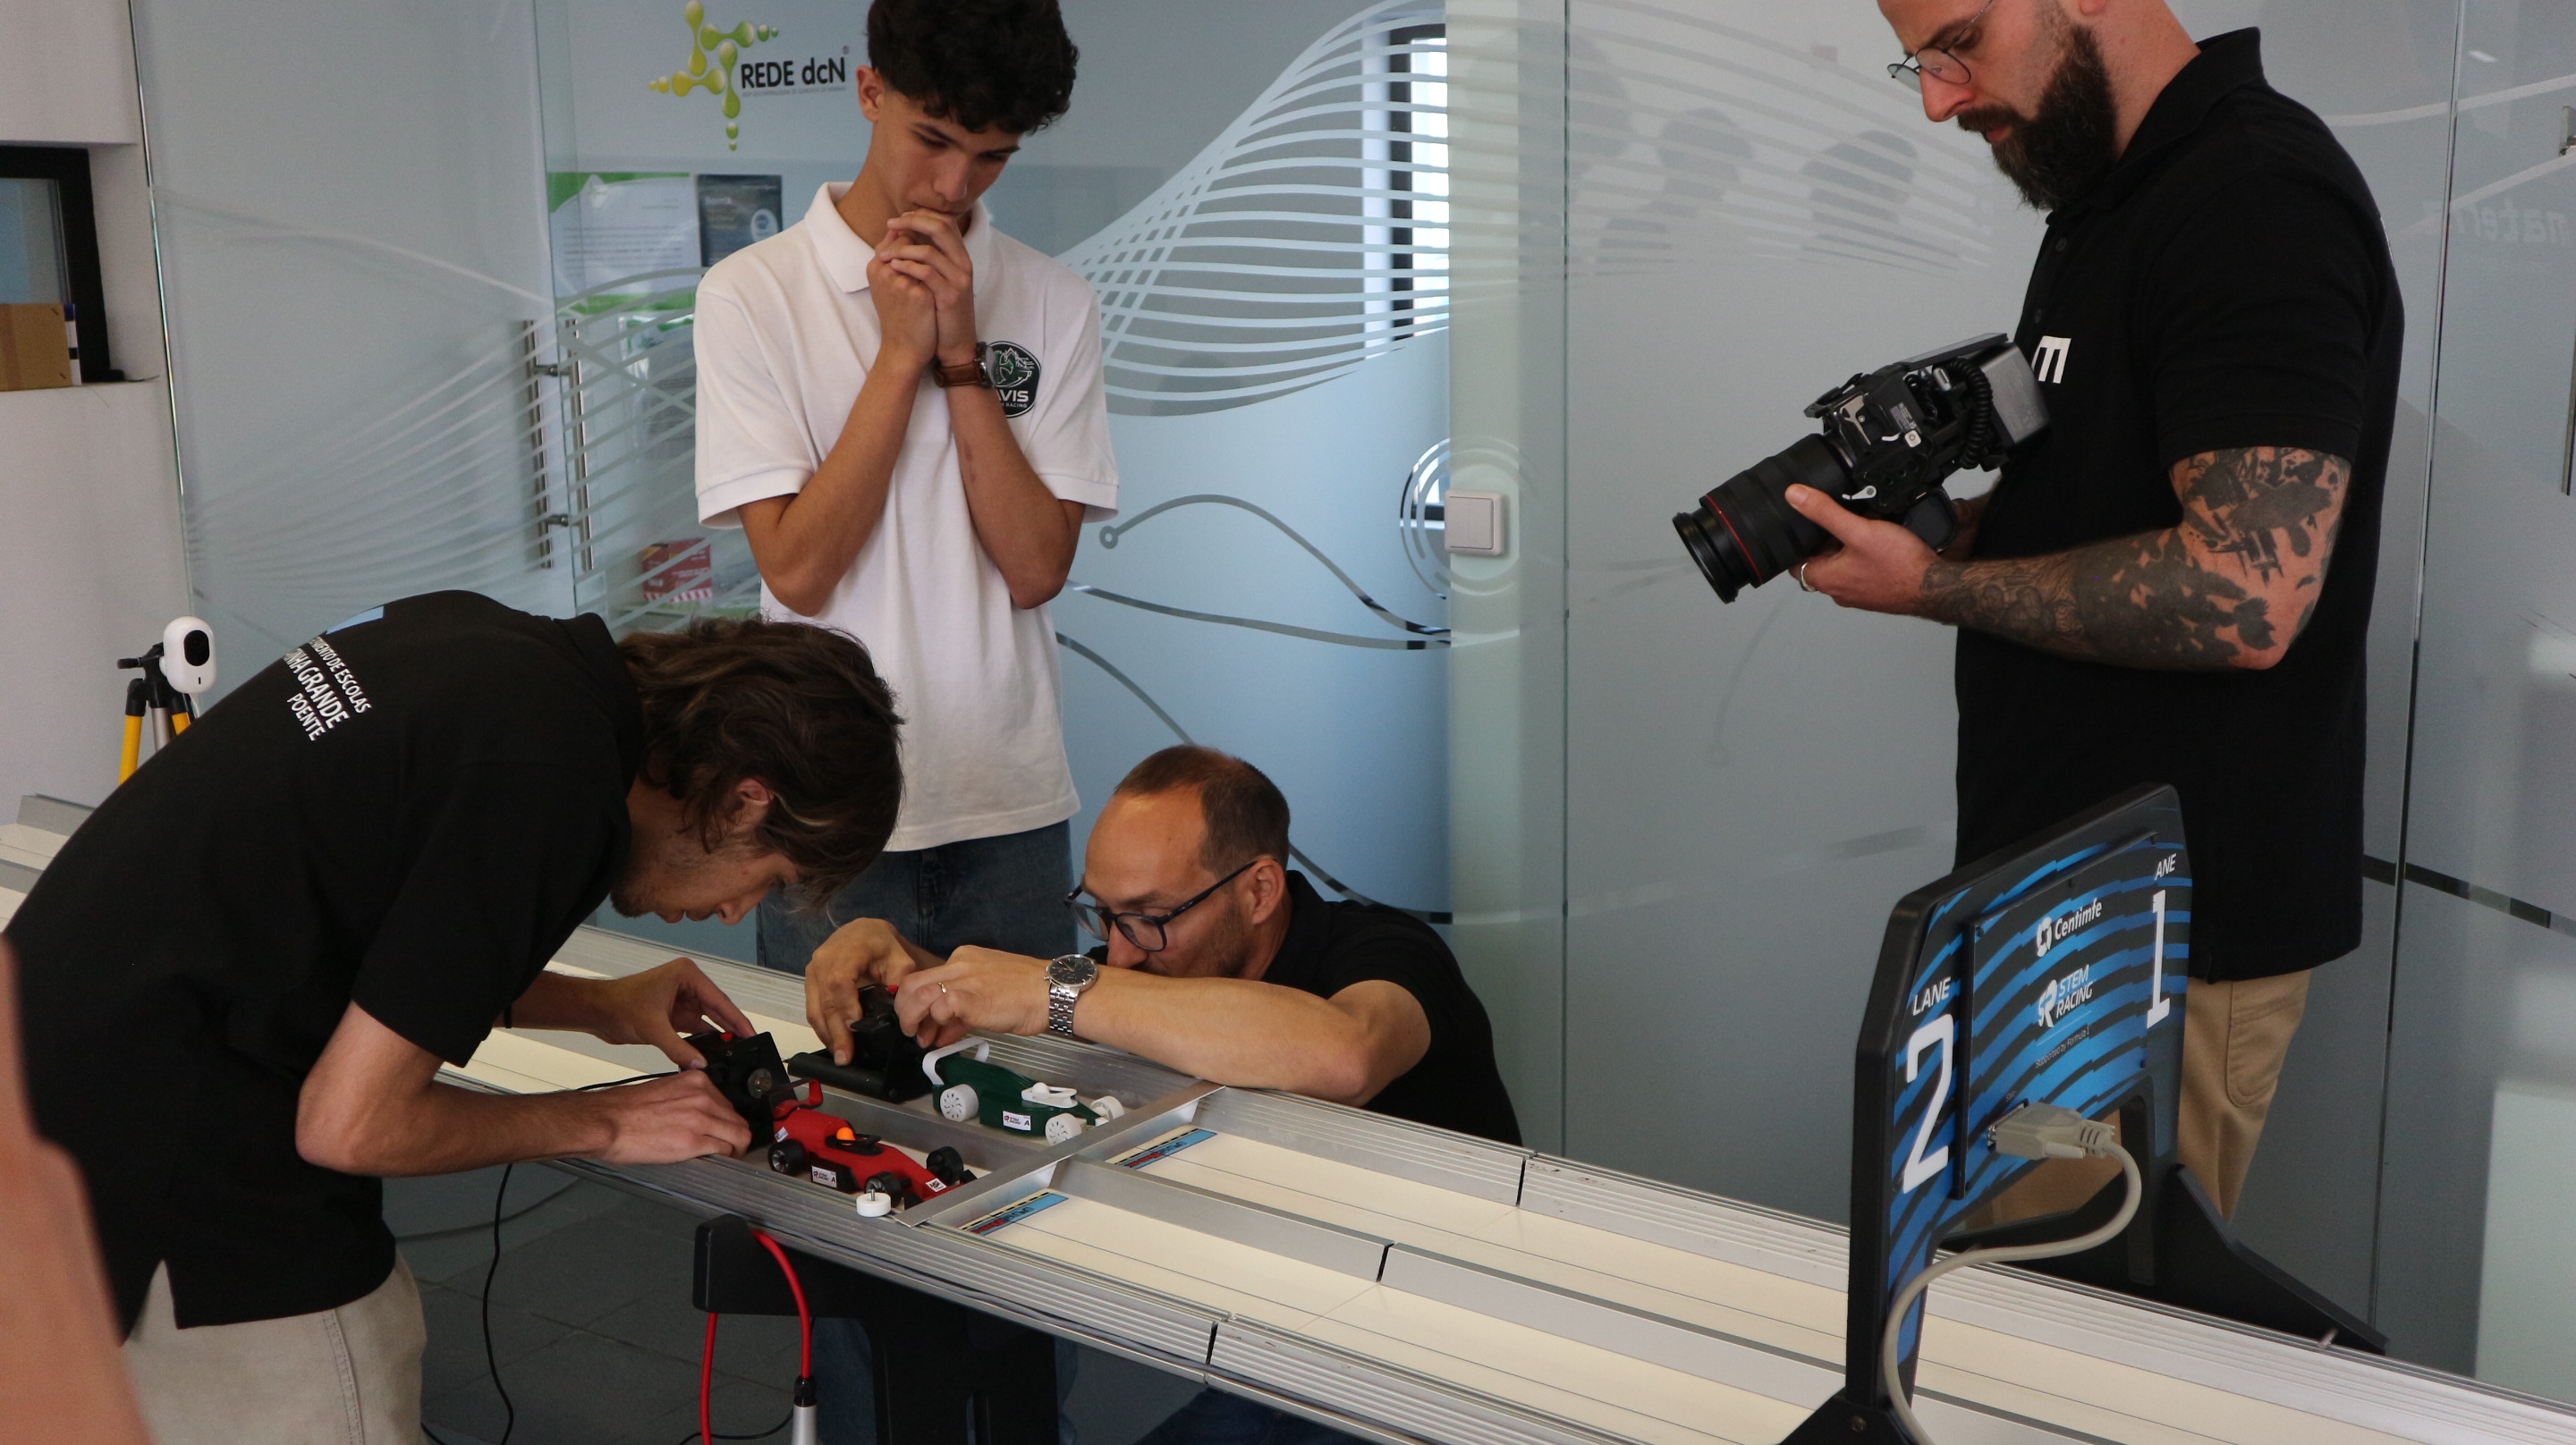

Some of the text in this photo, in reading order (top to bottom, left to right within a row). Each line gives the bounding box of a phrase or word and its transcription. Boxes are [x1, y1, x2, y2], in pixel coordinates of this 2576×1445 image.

[741, 60, 794, 89] REDE
[326, 657, 346, 672] DE
[297, 666, 350, 729] GRANDE
[335, 669, 372, 714] ESCOLAS
[286, 693, 326, 741] POENTE
[2055, 897, 2102, 940] Centimfe
[2147, 889, 2171, 1029] 1
[1912, 976, 1951, 1016] LANE
[2056, 981, 2094, 1018] RACING
[2058, 964, 2089, 998] STEM
[2067, 1029, 2087, 1046] Formula
[1902, 1013, 1953, 1195] 2
[831, 1176, 836, 1184] A
